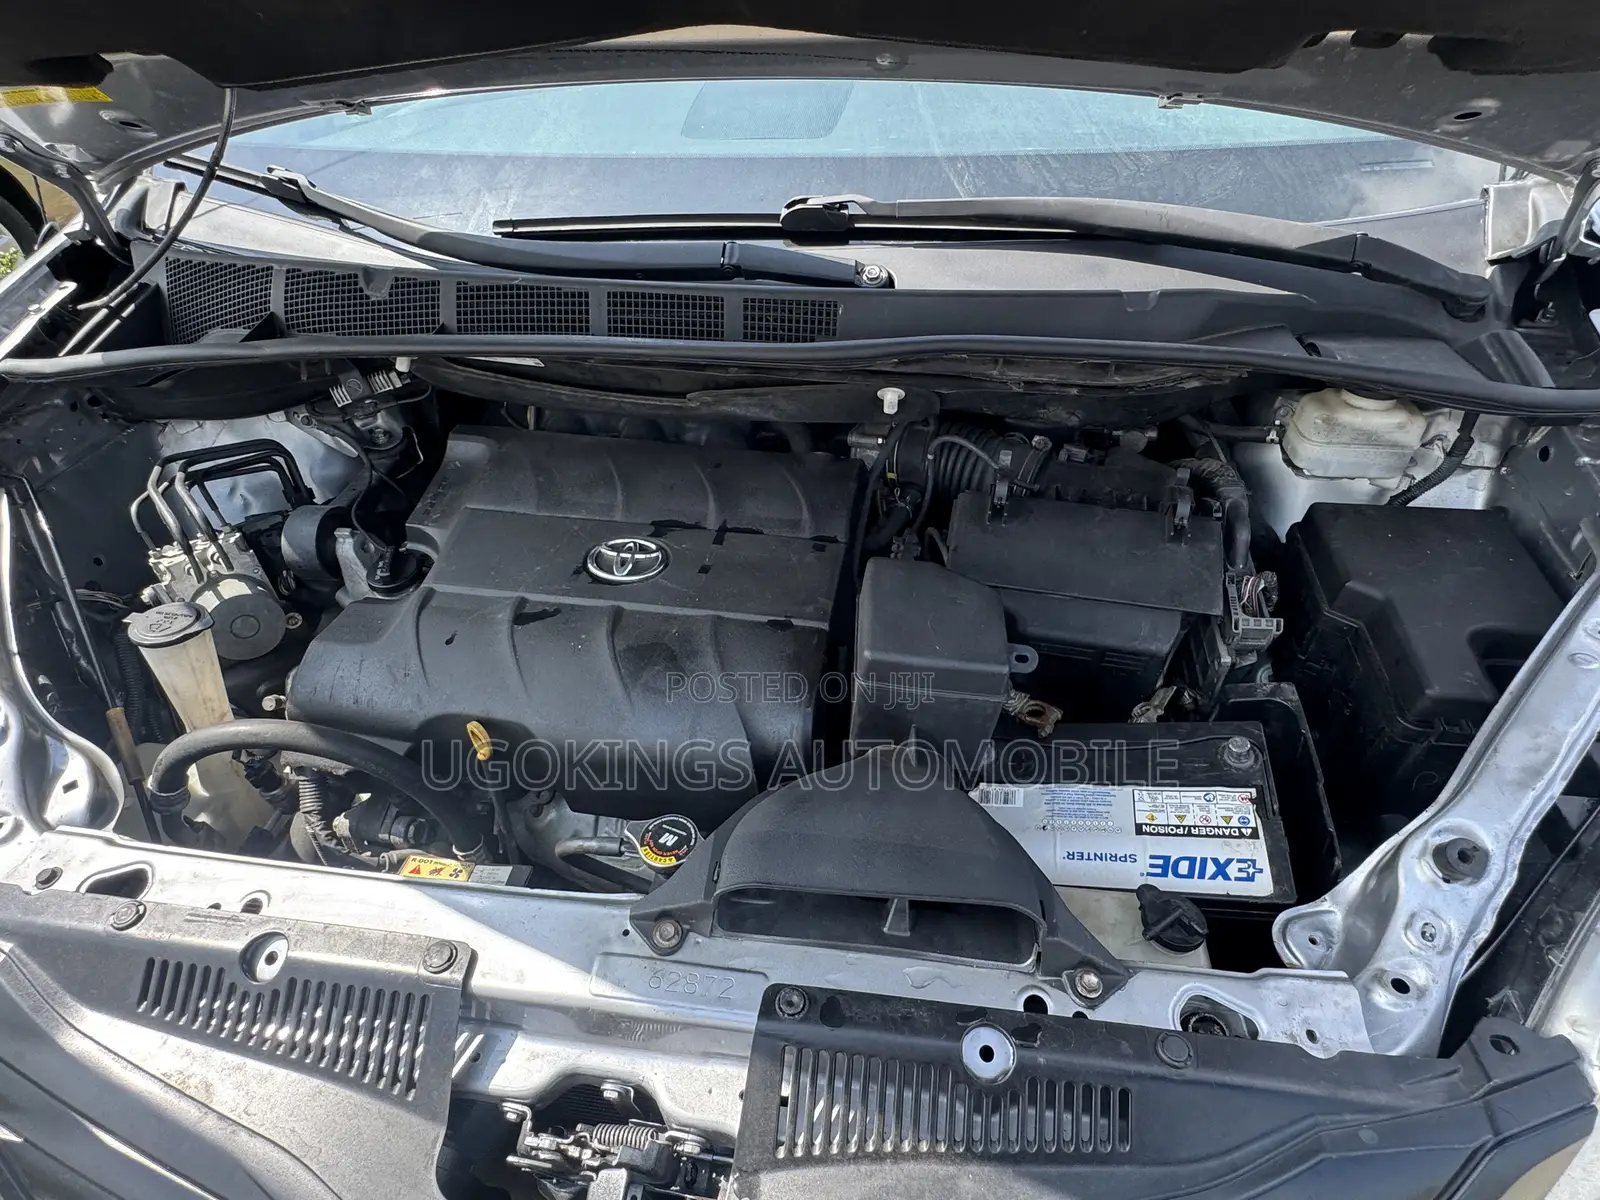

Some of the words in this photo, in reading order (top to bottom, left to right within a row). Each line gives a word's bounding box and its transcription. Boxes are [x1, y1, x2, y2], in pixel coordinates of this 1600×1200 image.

[1142, 824, 1184, 835] POISON
[1190, 826, 1239, 837] DANGER
[1065, 850, 1138, 863] SPRINTER
[1146, 853, 1264, 883] EXIDE
[648, 967, 736, 1000] 62872
